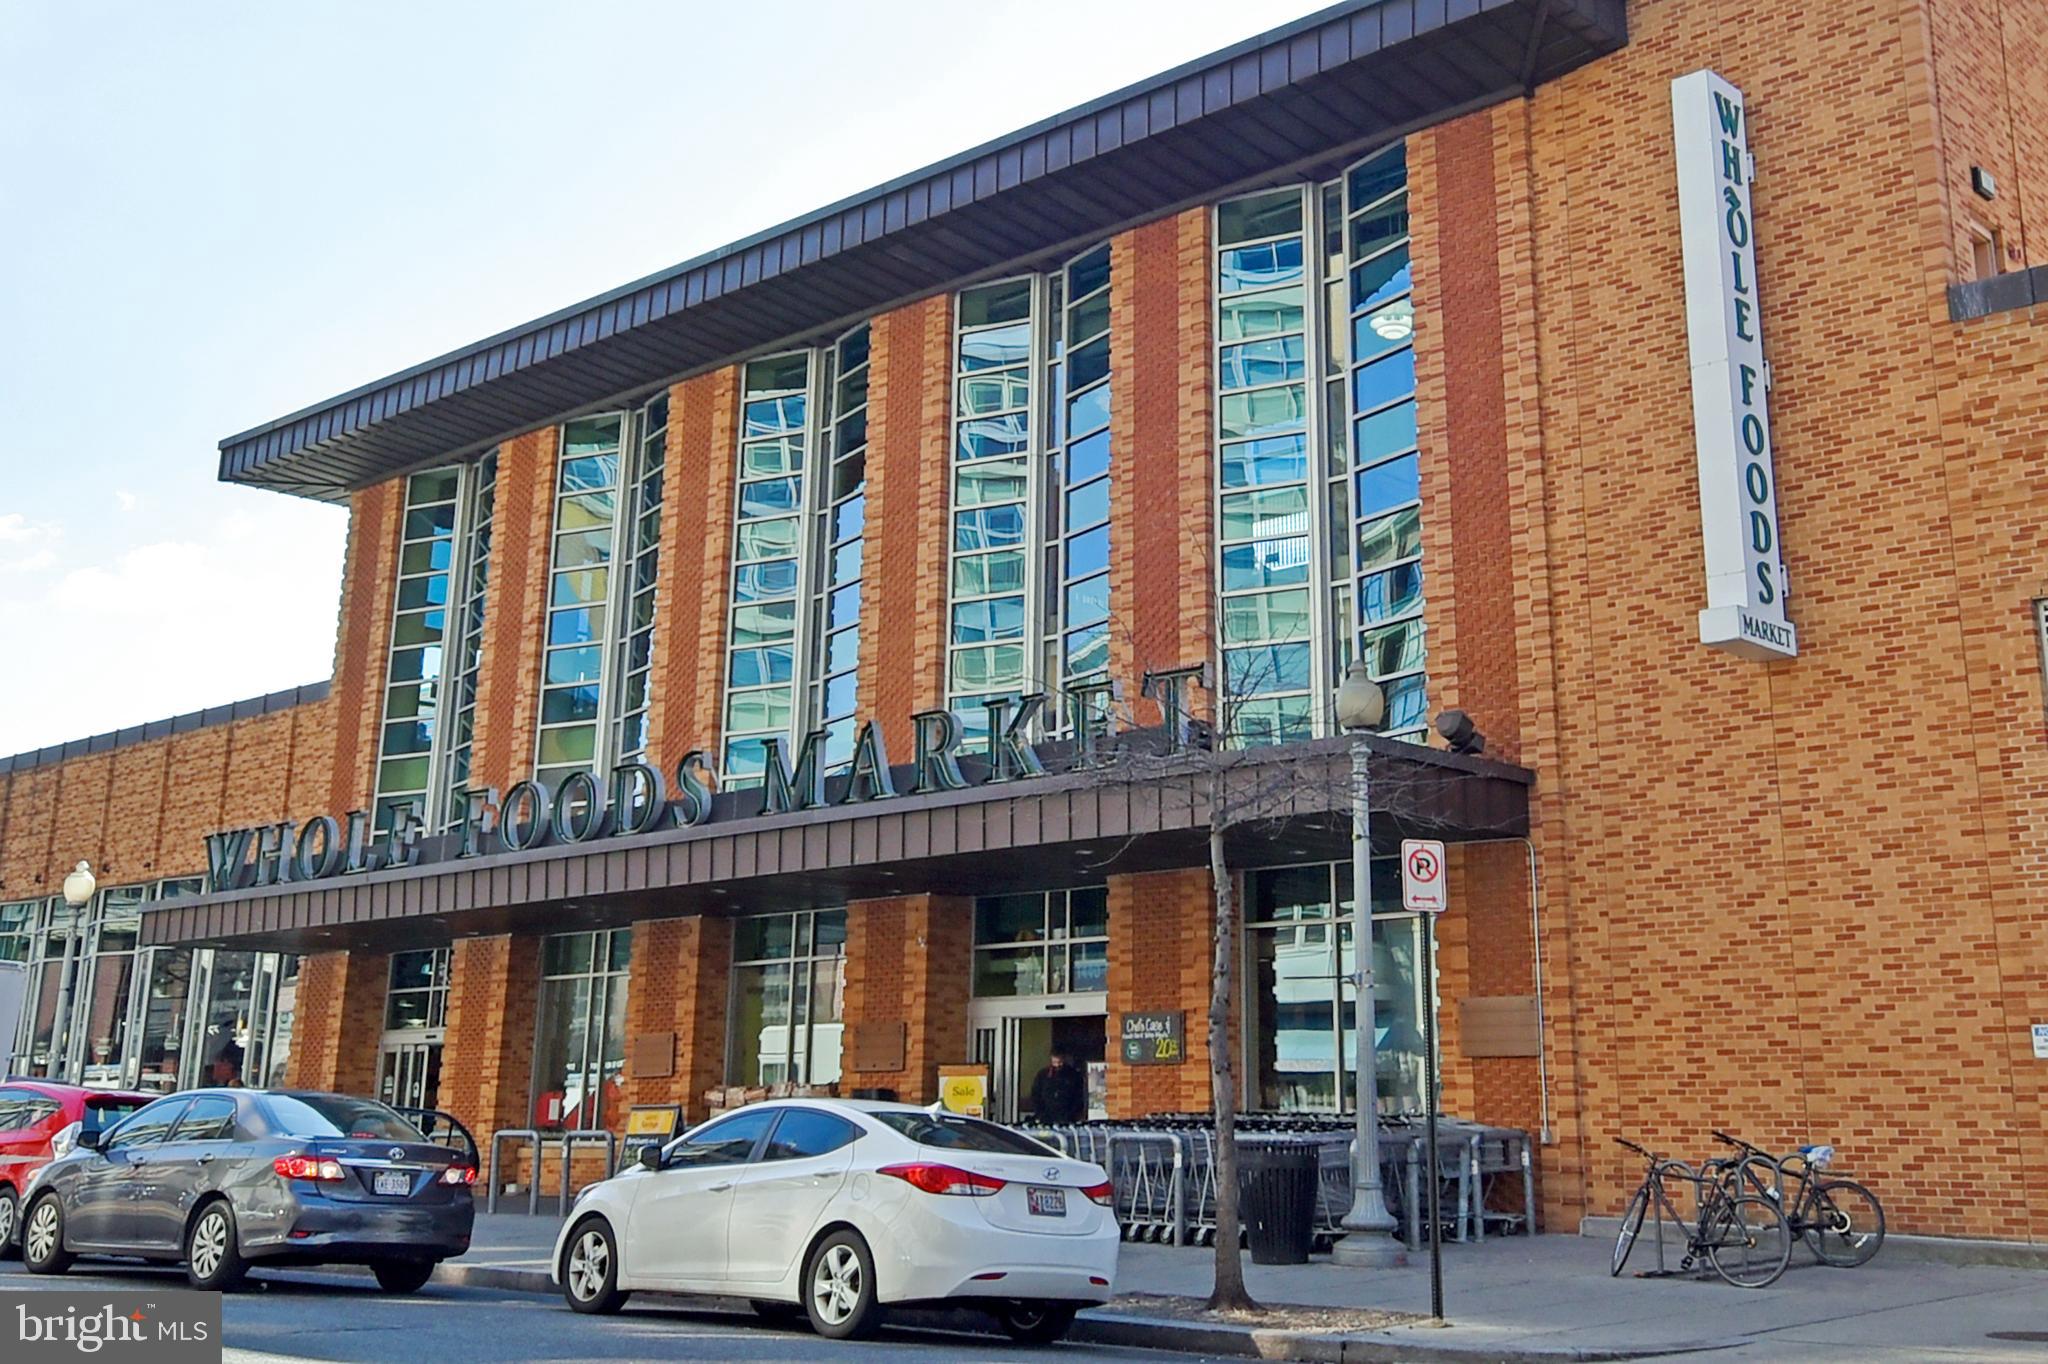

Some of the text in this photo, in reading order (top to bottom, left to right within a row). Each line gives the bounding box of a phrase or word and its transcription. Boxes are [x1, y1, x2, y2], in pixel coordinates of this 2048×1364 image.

[1713, 90, 1775, 605] WHOLE FOODS
[1742, 614, 1793, 649] MARKET
[205, 661, 1214, 893] WHOLE FOODS MARKET
[952, 1086, 976, 1097] Sale
